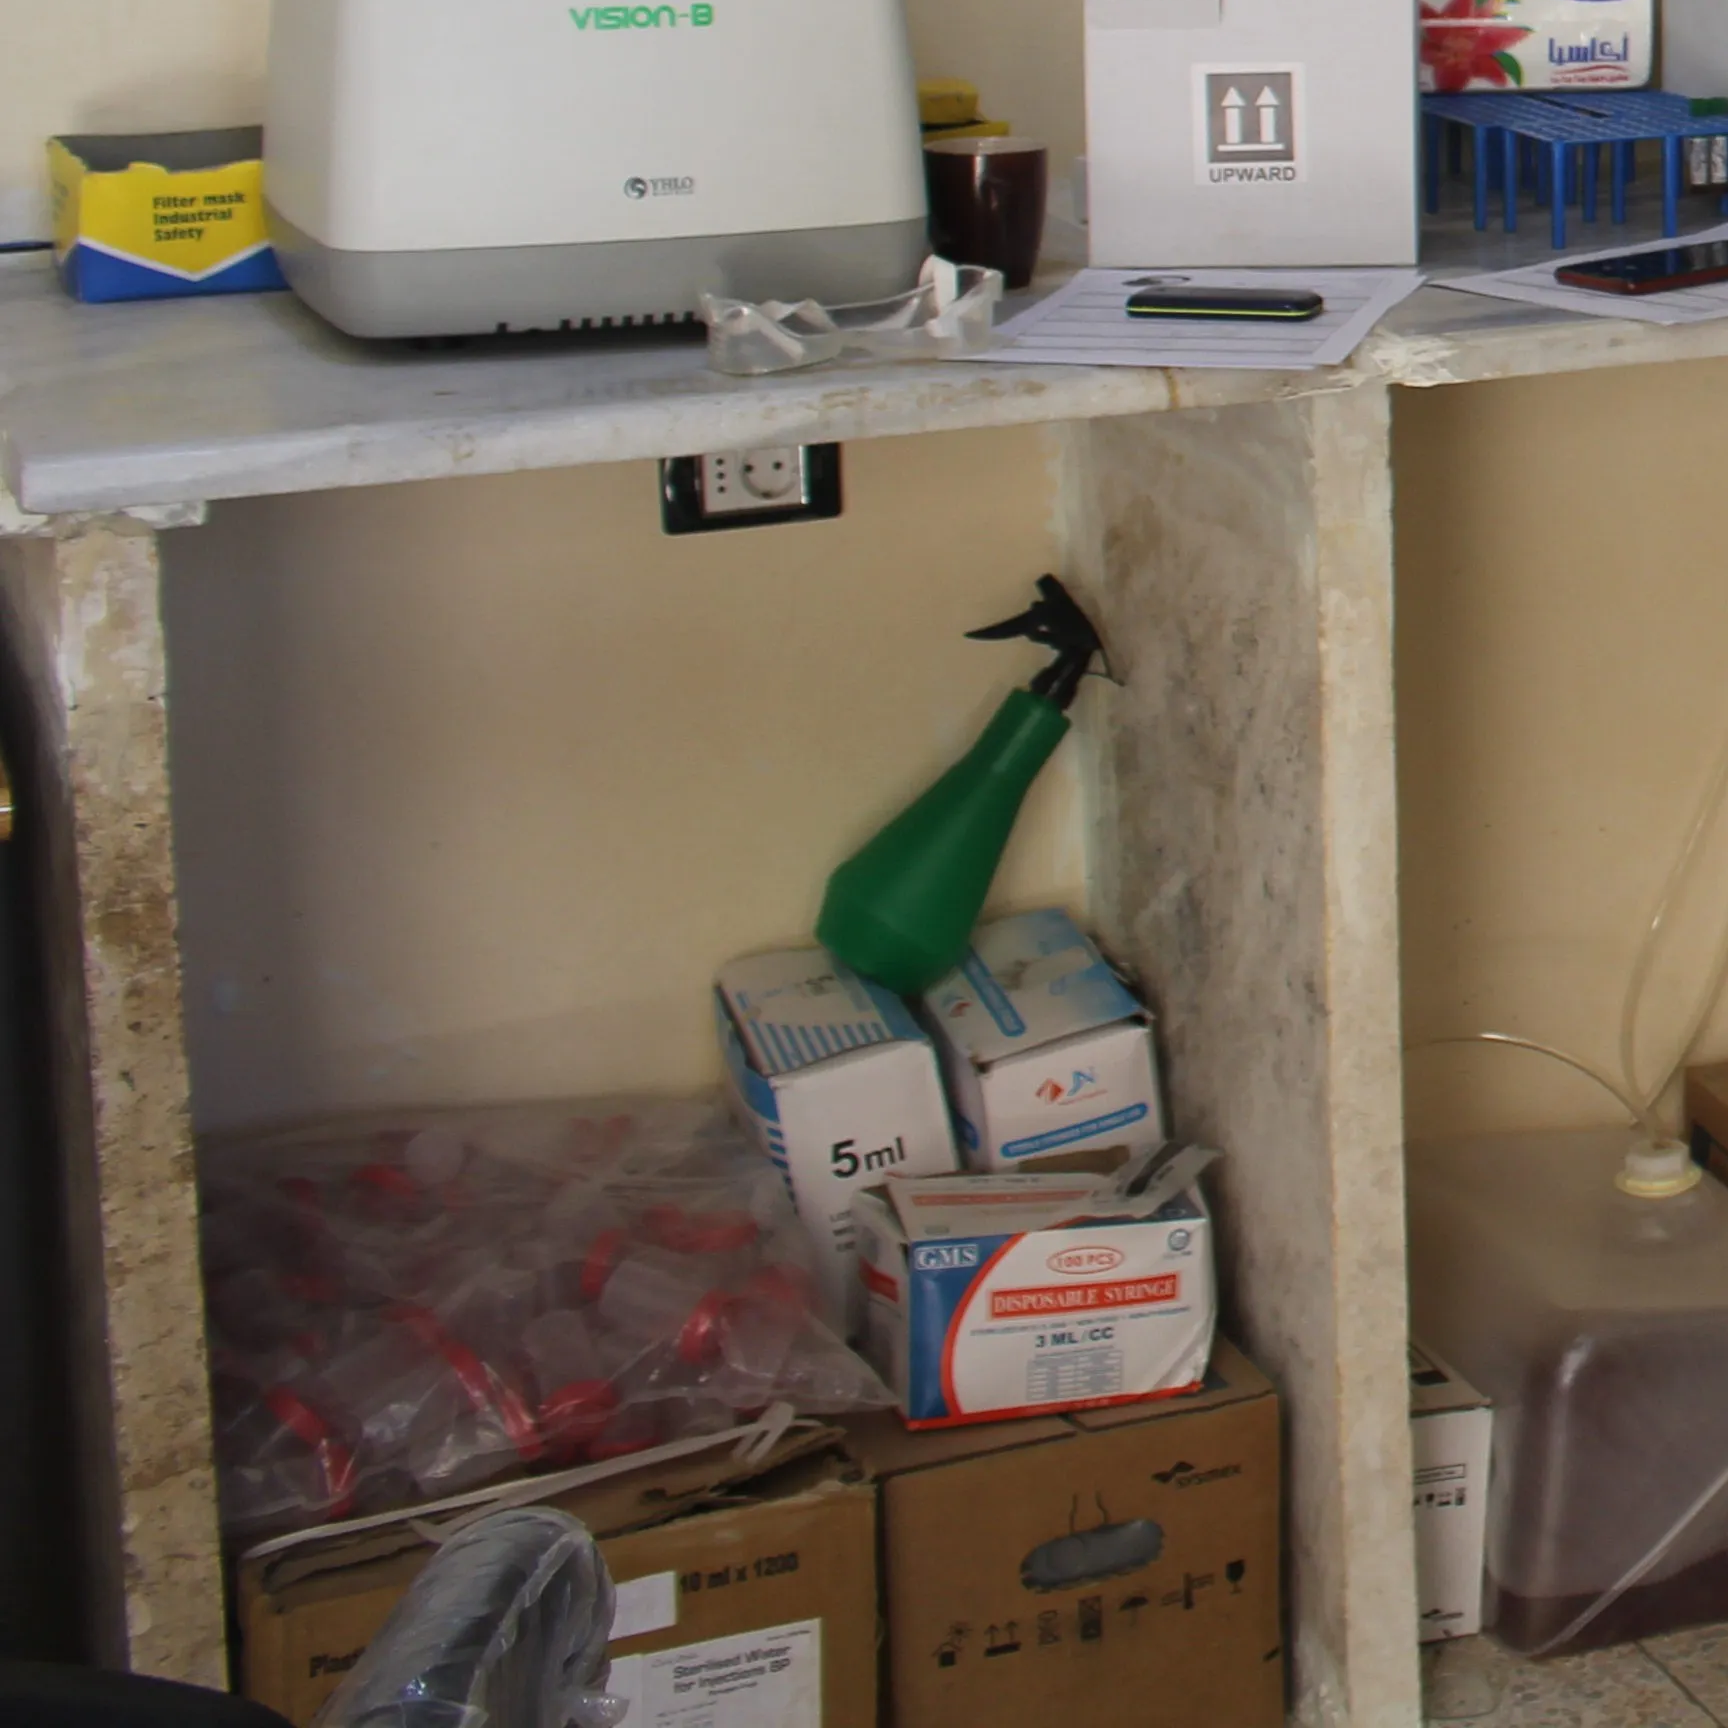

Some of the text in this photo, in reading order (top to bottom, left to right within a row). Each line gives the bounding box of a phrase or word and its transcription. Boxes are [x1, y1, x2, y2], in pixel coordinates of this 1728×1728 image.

[1209, 166, 1297, 183] UPWARD
[153, 192, 246, 209] Filter mask
[153, 208, 233, 225] Industrial
[154, 227, 204, 242] Safety
[918, 1247, 977, 1269] GMS
[1086, 1253, 1115, 1266] PCS
[993, 1278, 1176, 1313] DISPOSABLE SYRINGE
